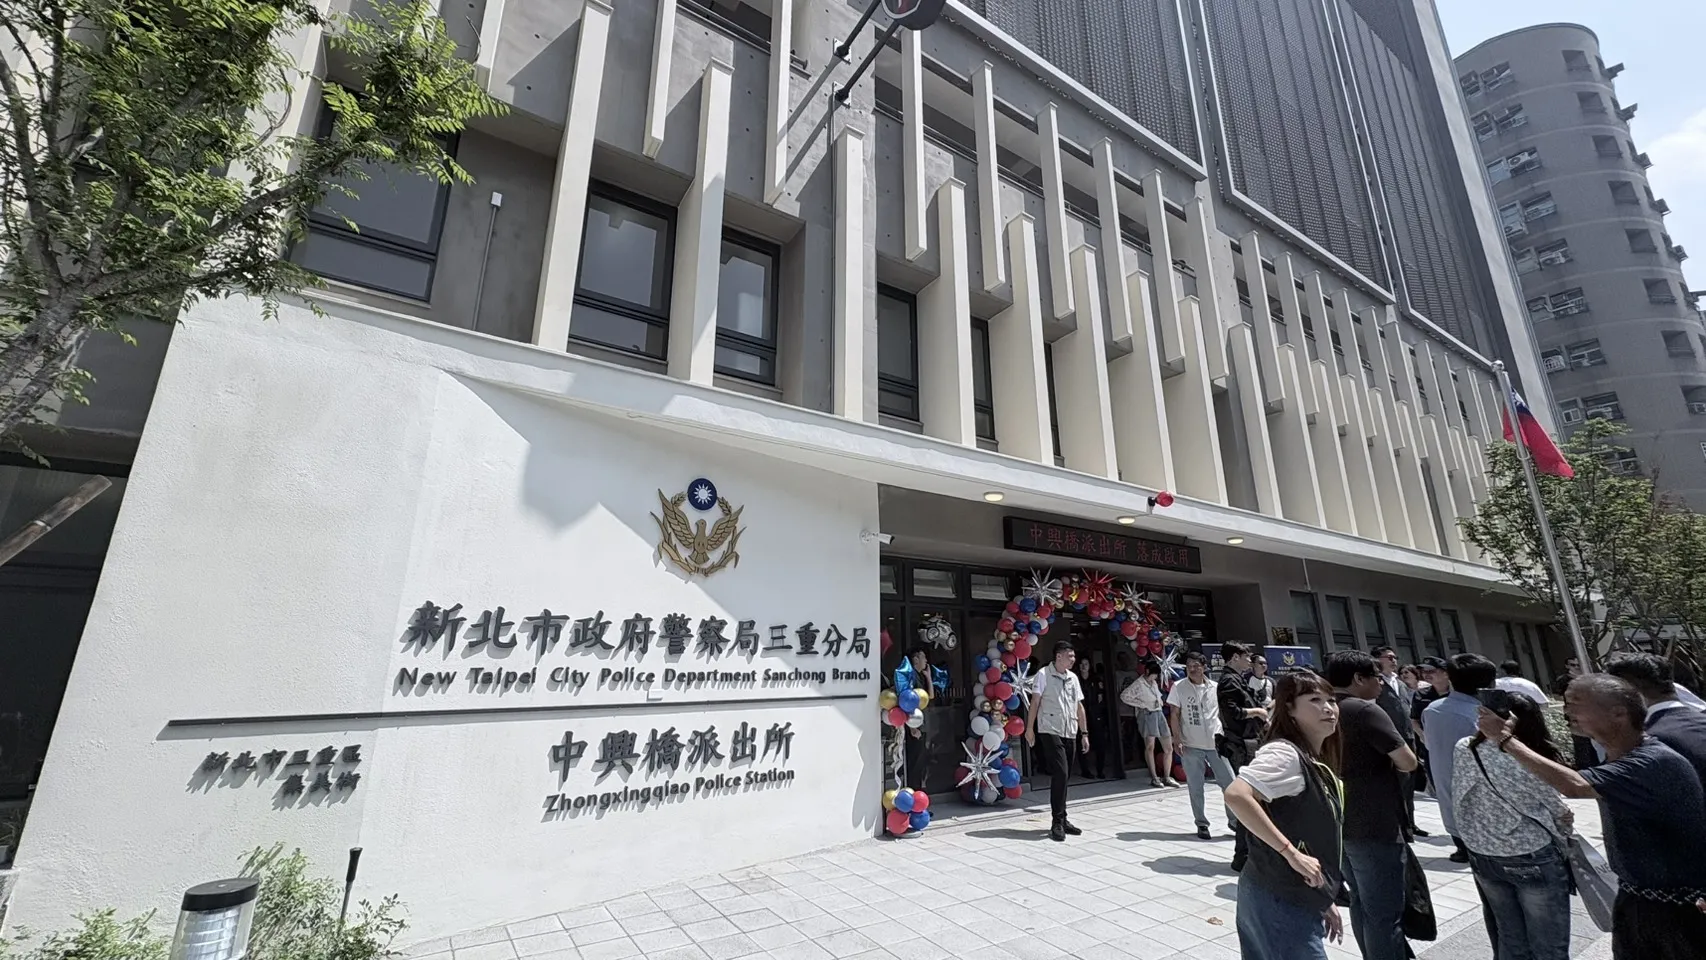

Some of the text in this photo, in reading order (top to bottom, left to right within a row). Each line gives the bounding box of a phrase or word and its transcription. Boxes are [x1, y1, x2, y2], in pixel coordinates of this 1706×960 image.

[1030, 523, 1127, 559] 中興橋派出所
[408, 600, 871, 658] 新北市政府警察局三重分局
[400, 666, 871, 689] New Taipei City Police Department Sanchong Branch
[203, 744, 362, 773] 新北市三重區
[551, 721, 796, 782] 中興橋派出所
[546, 768, 795, 813] Zhongxingqiao Police Station
